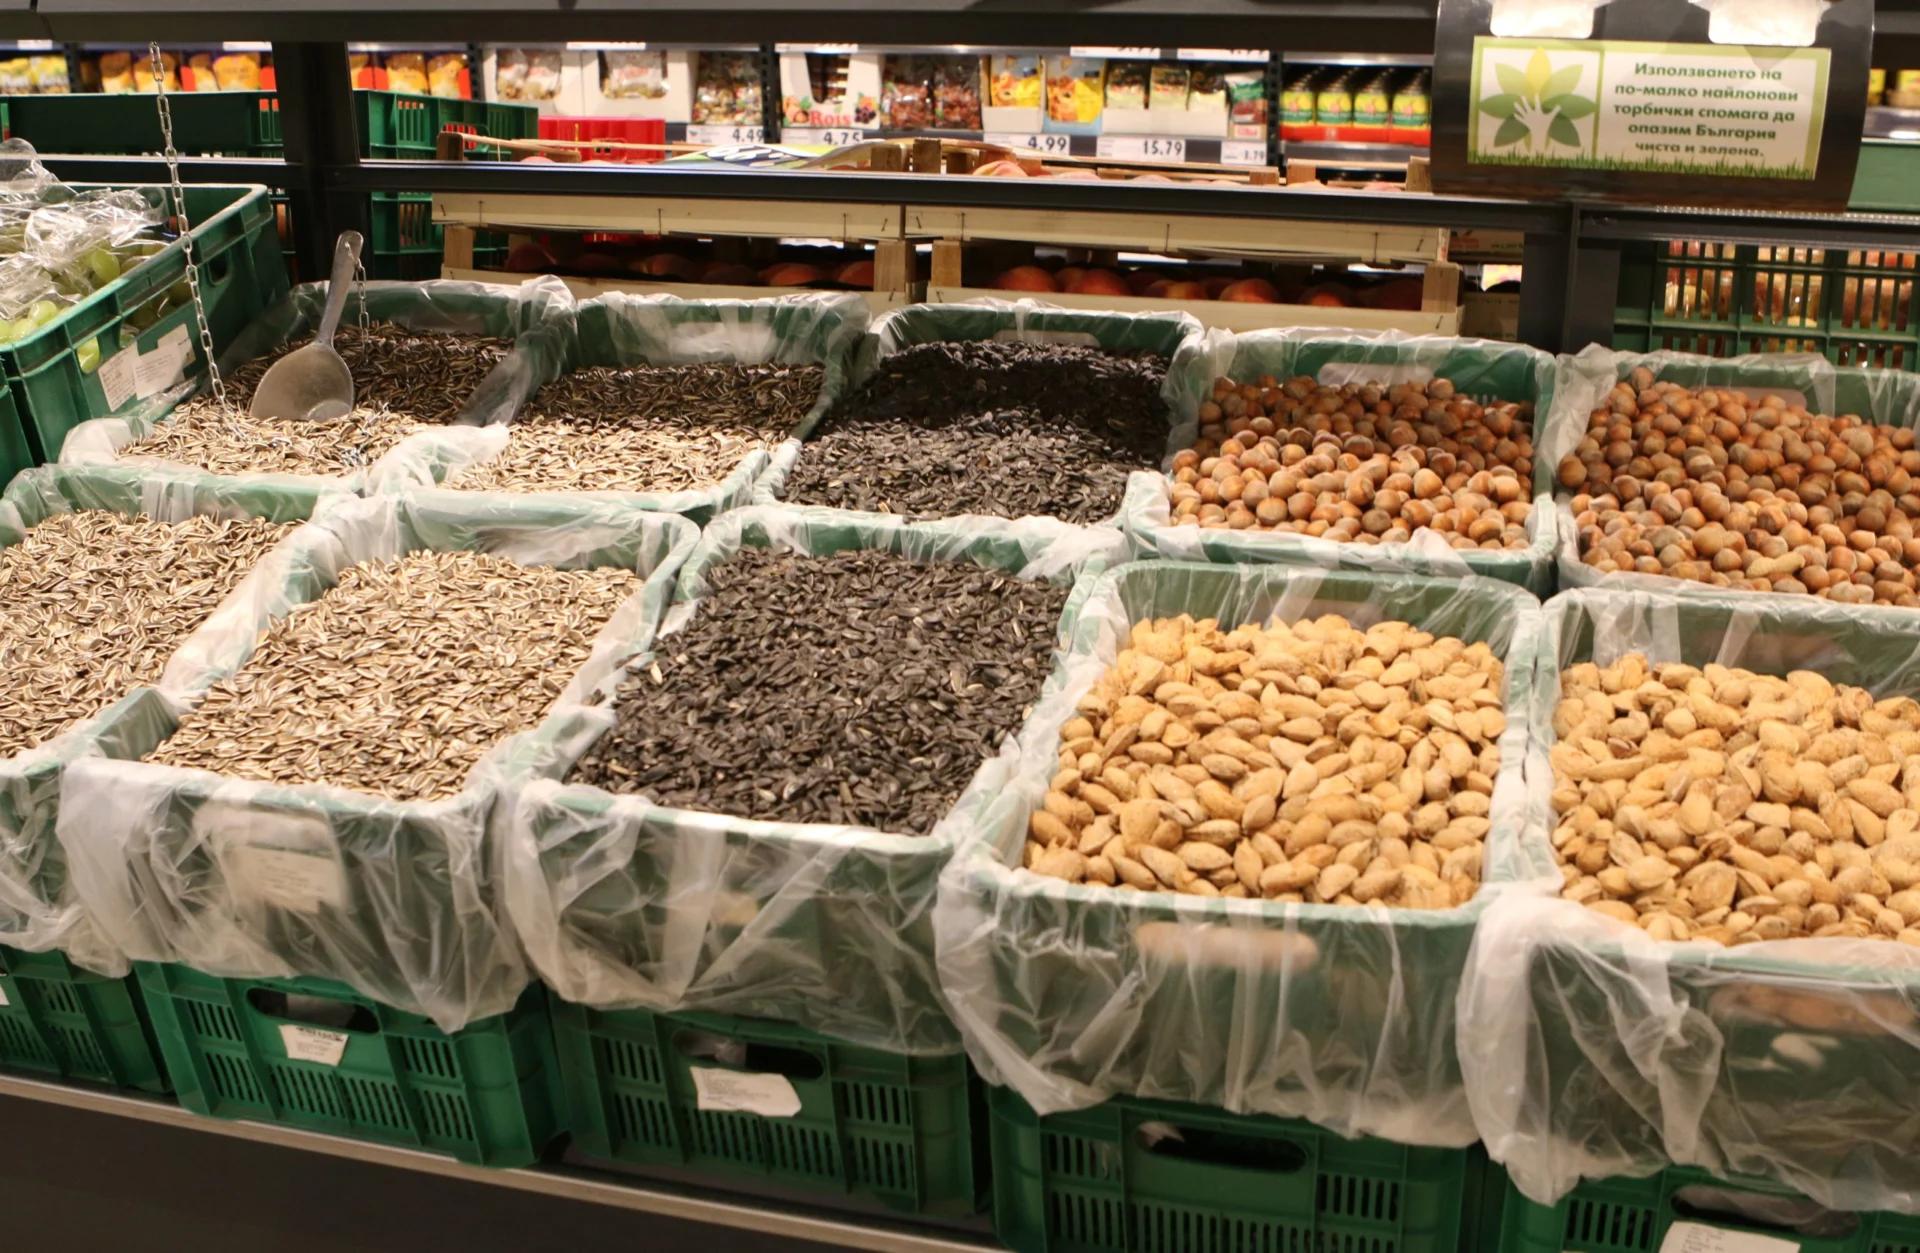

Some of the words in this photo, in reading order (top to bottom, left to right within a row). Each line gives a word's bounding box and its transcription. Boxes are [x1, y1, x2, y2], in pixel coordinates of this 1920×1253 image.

[1635, 63, 1756, 80] Използването
[1760, 70, 1782, 80] на
[1615, 84, 1698, 97] по-малко
[1702, 86, 1798, 101] найлонови
[1614, 102, 1694, 117] торбички
[1698, 107, 1769, 120] спомага
[1772, 111, 1795, 122] да
[1628, 123, 1691, 136] опазим
[1696, 125, 1776, 140] България
[1027, 136, 1067, 150] 4.99
[1143, 140, 1182, 155] 15.79
[1635, 141, 1681, 152] чиста
[1685, 145, 1695, 153] и
[1699, 145, 1764, 156] зелена.
